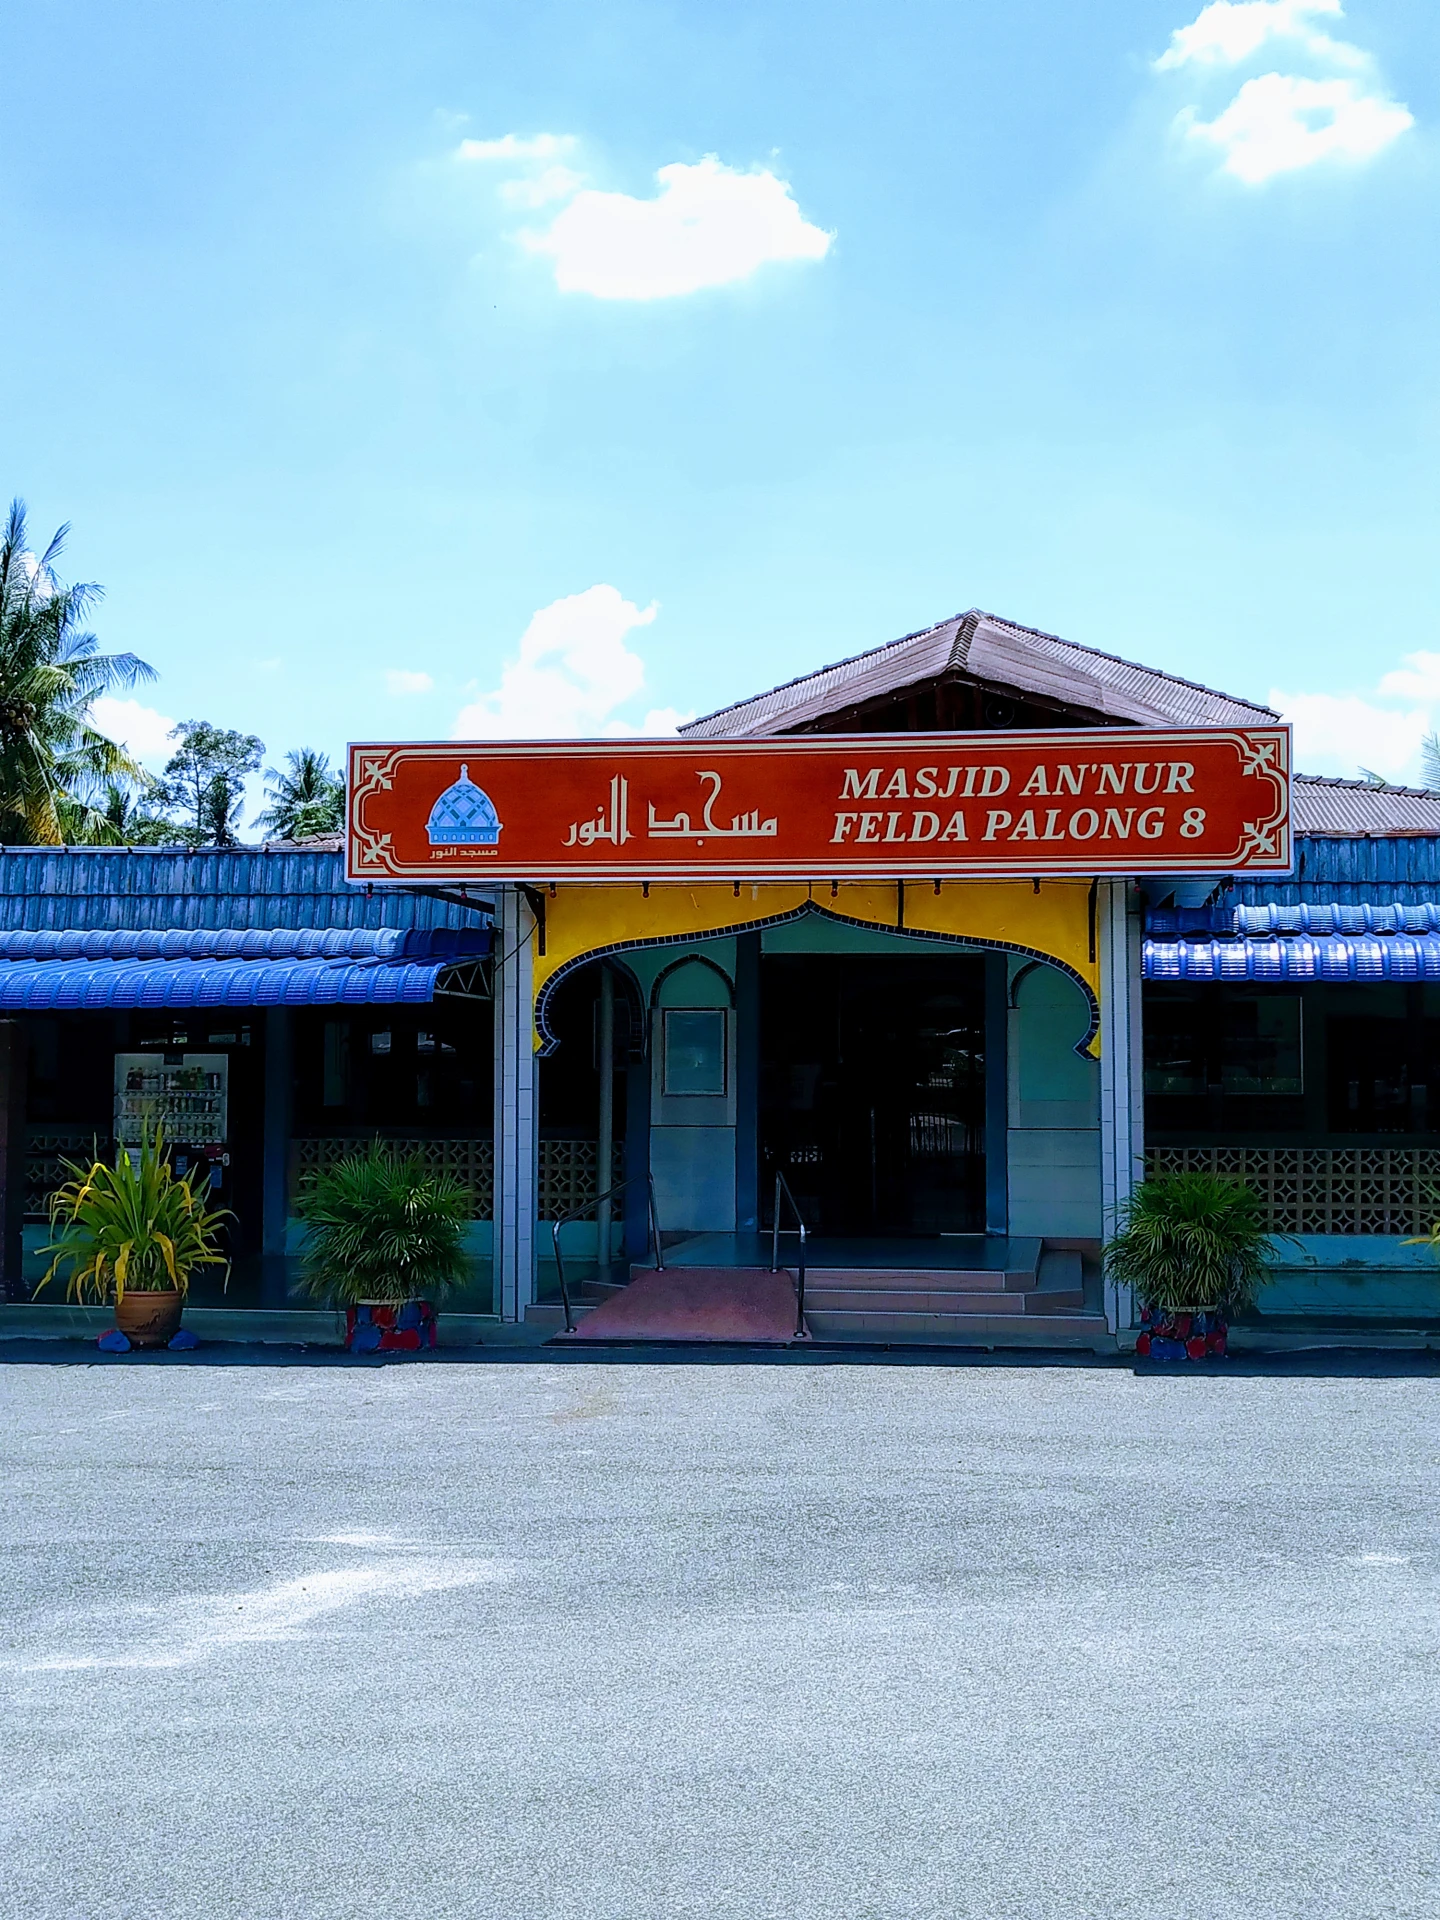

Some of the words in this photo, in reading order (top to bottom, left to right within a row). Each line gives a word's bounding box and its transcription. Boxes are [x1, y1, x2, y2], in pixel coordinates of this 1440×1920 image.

[838, 766, 1011, 800] MASJID
[1018, 761, 1195, 797] AN'NUR
[560, 773, 636, 846] النور
[648, 770, 778, 846] مسجد
[829, 810, 970, 843] FELDA
[980, 806, 1167, 841] PALONG
[1179, 807, 1207, 839] 8
[429, 847, 457, 859] النور
[459, 849, 498, 858] مسجد
